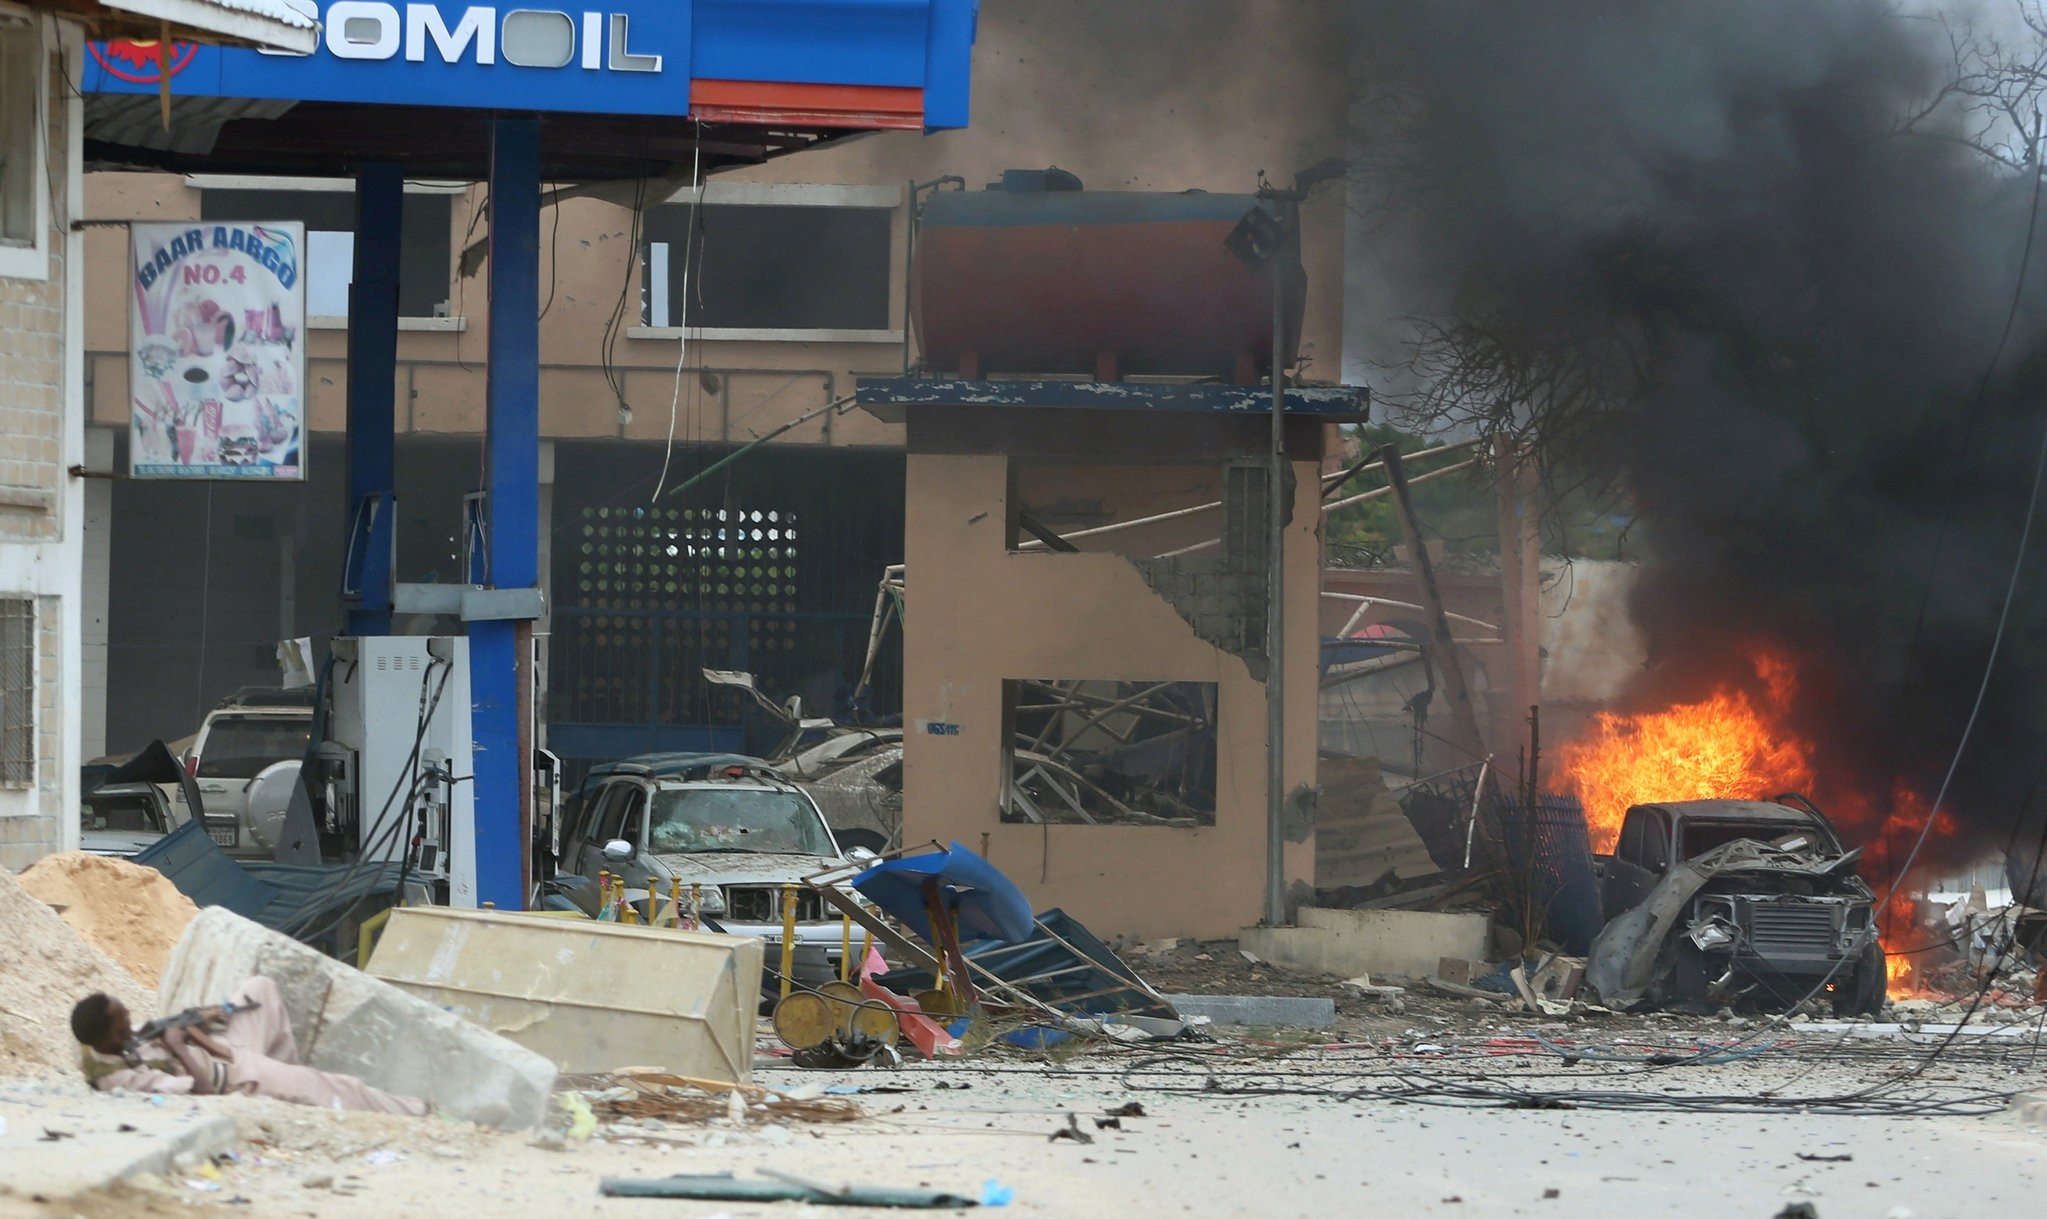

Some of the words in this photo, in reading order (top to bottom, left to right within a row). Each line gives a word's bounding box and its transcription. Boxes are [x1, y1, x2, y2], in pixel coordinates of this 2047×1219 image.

[256, 0, 663, 73] OMOIL
[138, 229, 204, 291] BAAR
[213, 226, 297, 290] AARGO
[184, 264, 247, 285] NO.4
